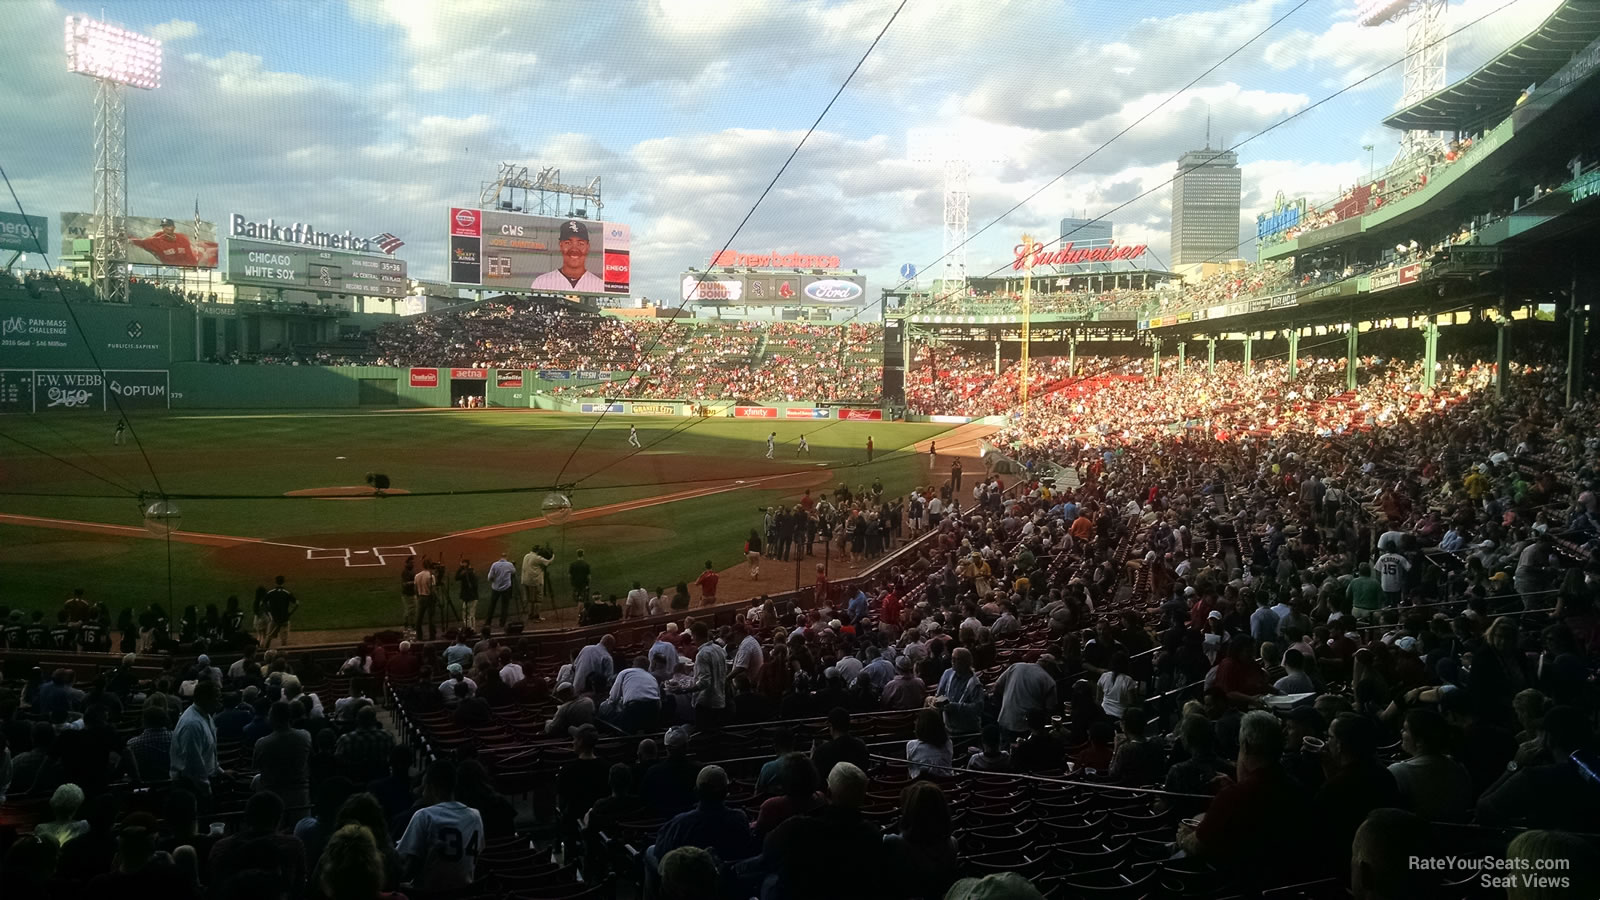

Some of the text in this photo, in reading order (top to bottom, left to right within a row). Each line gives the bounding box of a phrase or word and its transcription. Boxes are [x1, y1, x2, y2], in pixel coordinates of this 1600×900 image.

[68, 227, 86, 236] MY
[230, 213, 370, 252] Bank of America
[501, 224, 524, 236] CWS
[248, 252, 291, 266] CHICAGO
[1013, 239, 1148, 270] Budweiser
[244, 265, 295, 280] WHITE SOX
[381, 262, 401, 272] 35-36
[606, 264, 628, 272] ENEOS
[815, 284, 852, 298] Ford
[29, 319, 66, 327] PAN-MASS
[37, 374, 61, 386] F.W.
[65, 374, 102, 386] WEBB
[123, 385, 165, 396] OPTUM
[660, 405, 674, 415] CITY
[1382, 564, 1397, 575] 15
[84, 630, 95, 643] 16
[438, 826, 479, 862] 34
